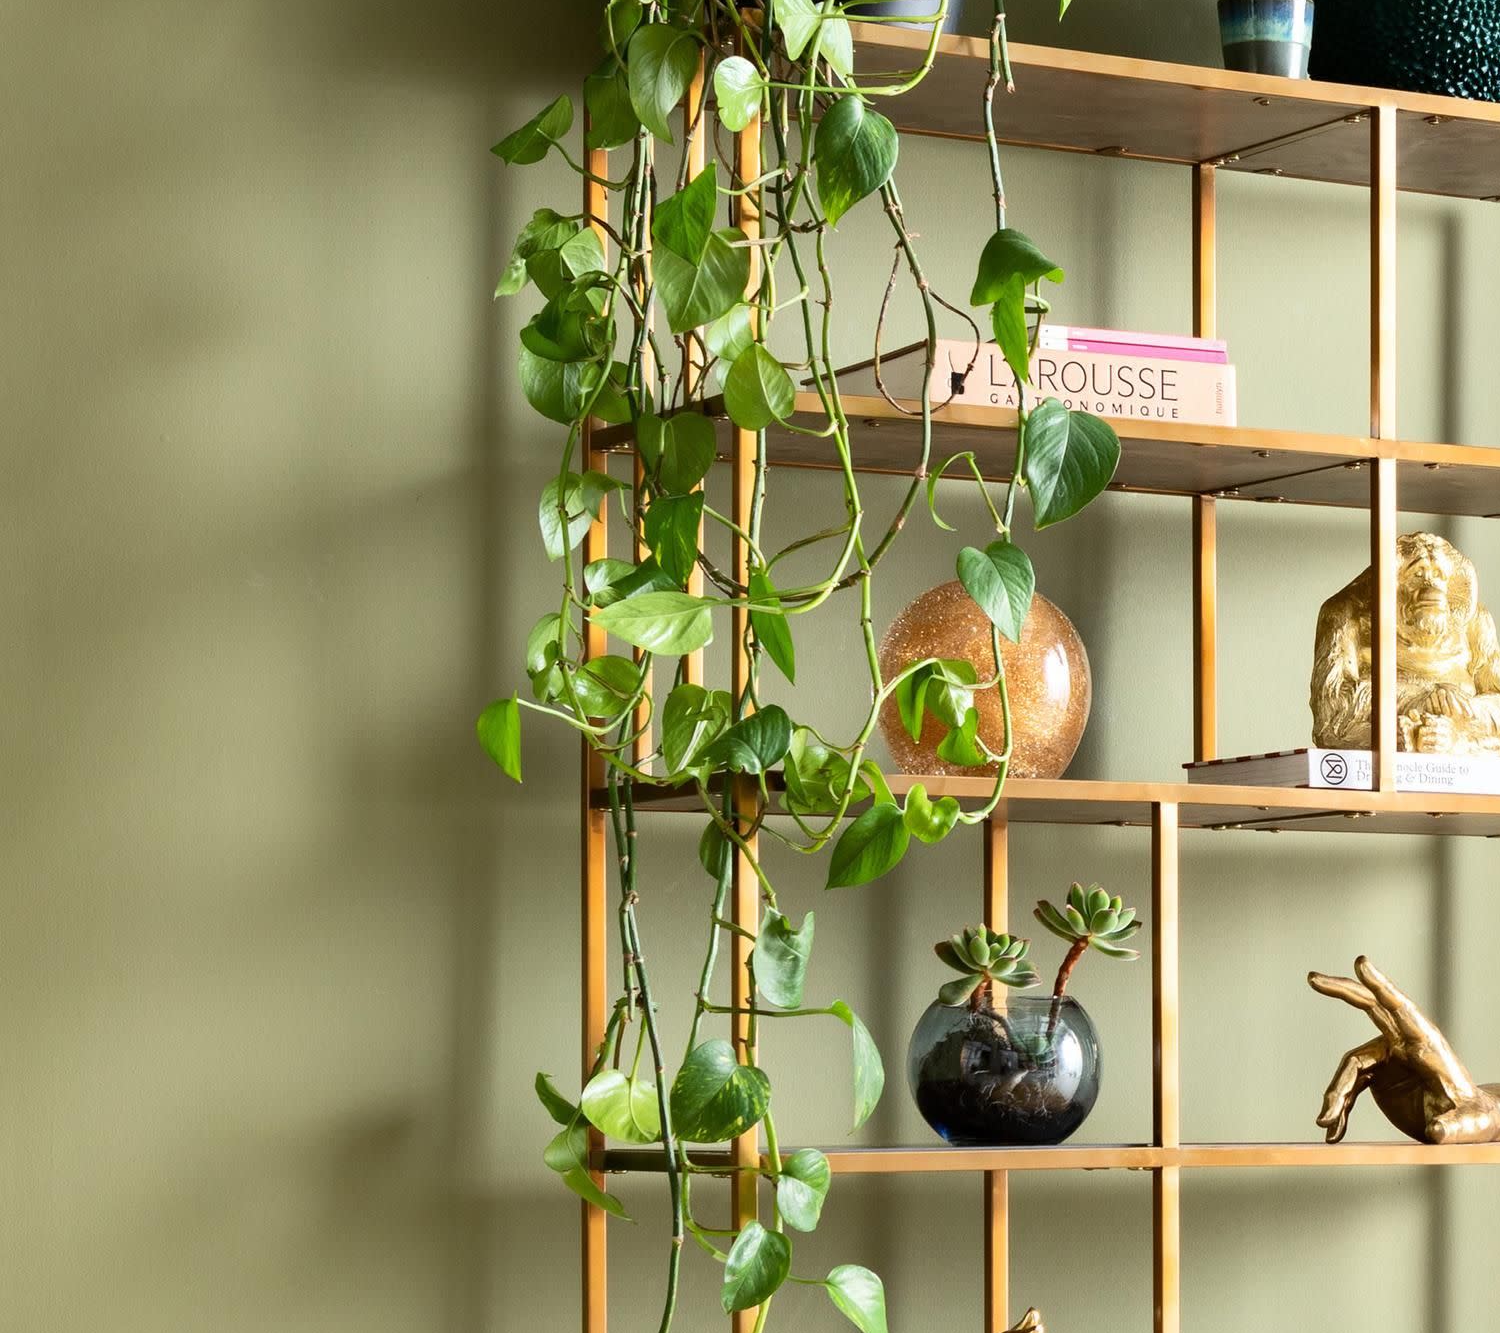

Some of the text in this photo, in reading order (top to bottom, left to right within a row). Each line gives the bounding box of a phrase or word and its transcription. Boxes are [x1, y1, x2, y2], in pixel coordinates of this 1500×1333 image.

[989, 392, 1179, 419] GATONOMIQUE
[1355, 759, 1371, 771] Th
[1426, 762, 1456, 775] Guide
[1459, 765, 1470, 776] to
[1419, 773, 1454, 786] Dining
